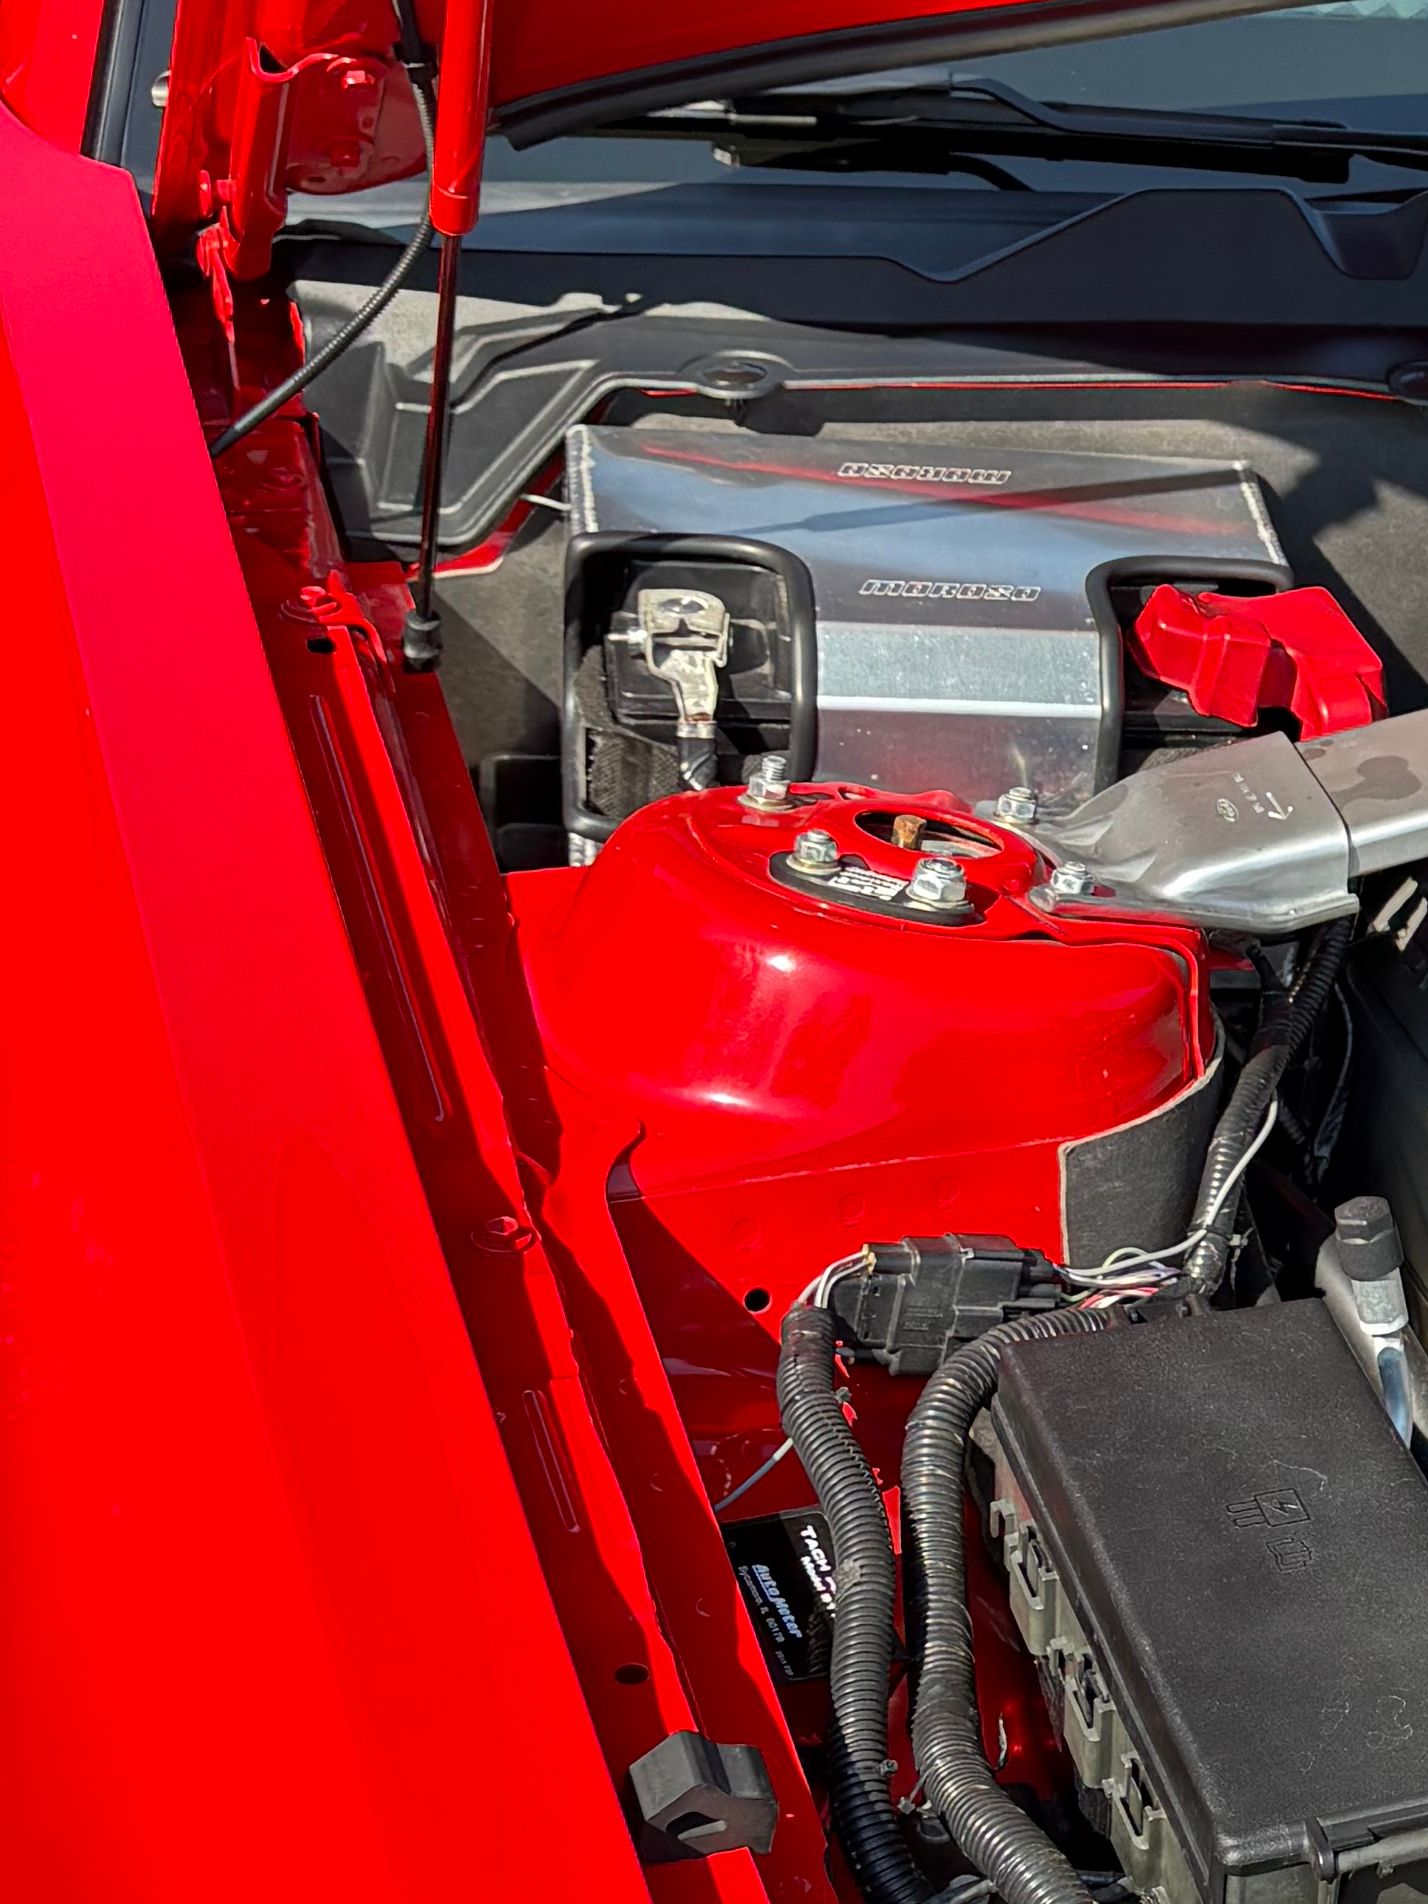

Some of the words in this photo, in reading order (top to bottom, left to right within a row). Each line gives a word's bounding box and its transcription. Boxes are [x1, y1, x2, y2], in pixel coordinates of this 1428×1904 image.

[837, 462, 1011, 484] MOROSO
[858, 579, 1041, 601] MOROSO
[800, 1525, 832, 1572] TACH
[801, 1556, 827, 1592] Model
